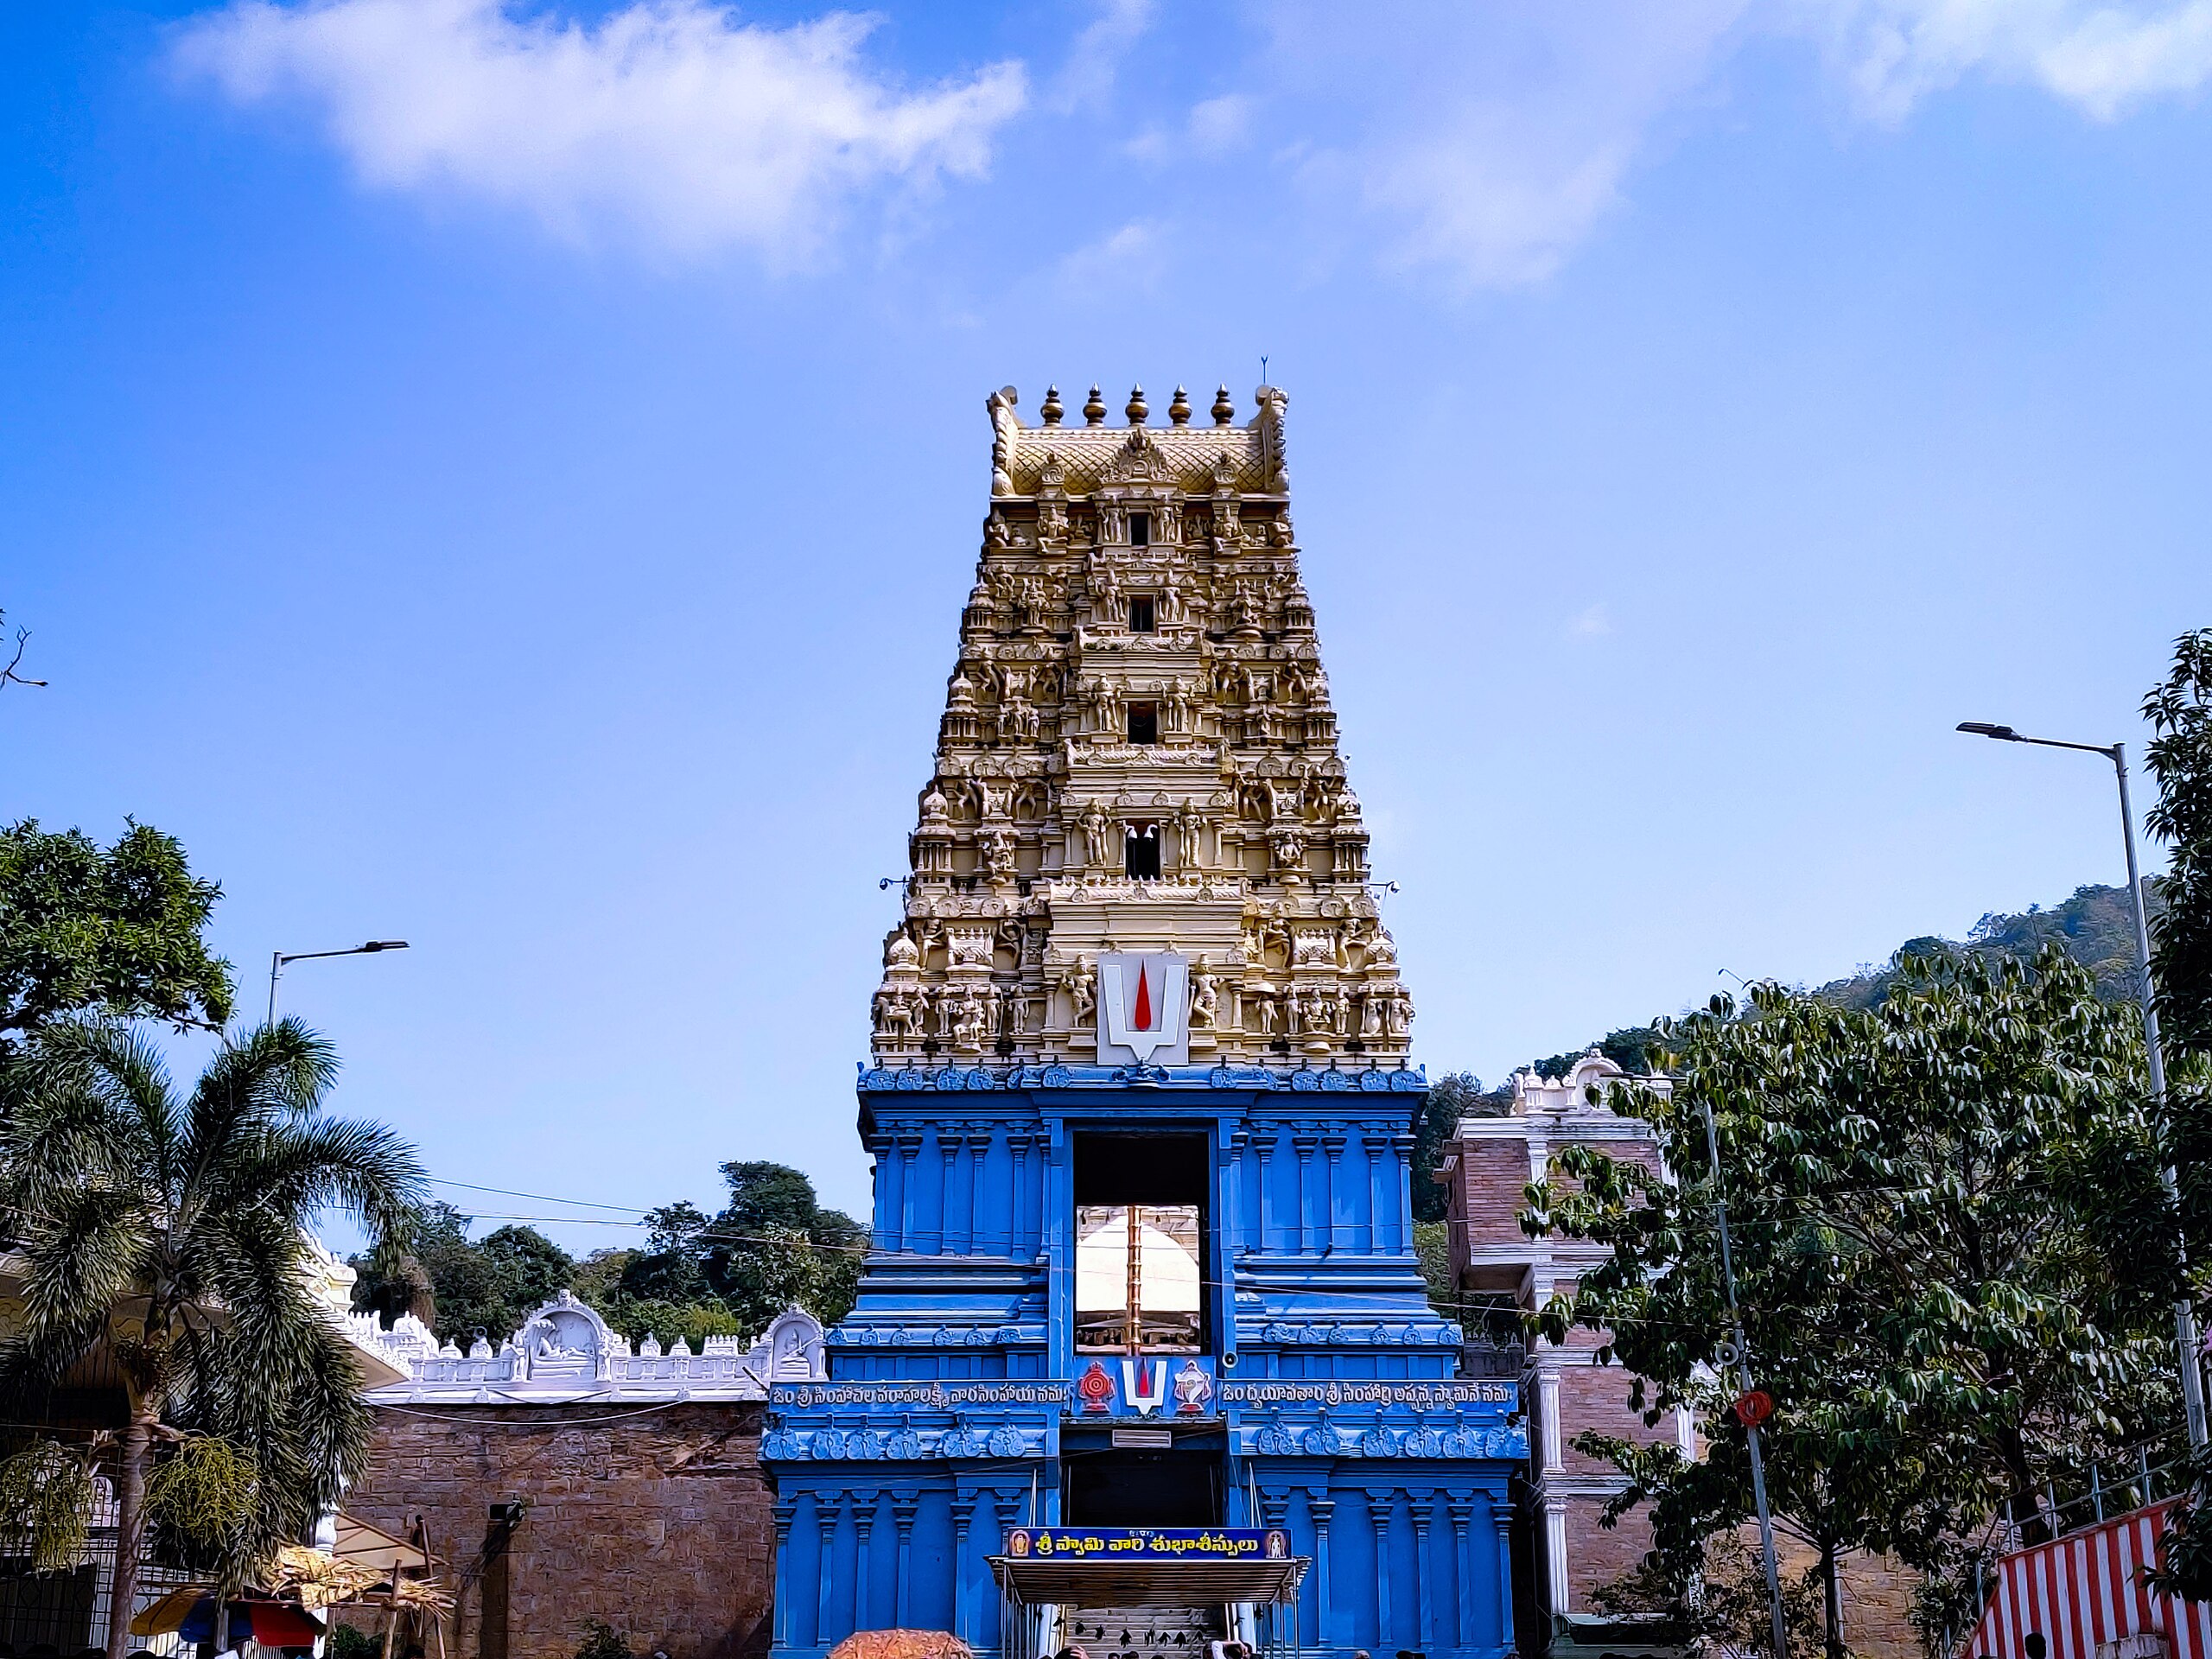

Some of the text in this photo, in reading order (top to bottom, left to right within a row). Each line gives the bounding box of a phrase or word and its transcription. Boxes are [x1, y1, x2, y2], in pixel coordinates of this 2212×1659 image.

[773, 1385, 794, 1403] ఓం
[798, 1385, 812, 1408] శ్రీ
[1224, 1384, 1243, 1402] ఓం
[1326, 1382, 1341, 1405] శ్రీ
[1482, 1384, 1513, 1402] నమః
[1035, 1531, 1053, 1555] శ్రీ
[1056, 1535, 1104, 1555] స్వామి
[1109, 1537, 1145, 1552] వారి
